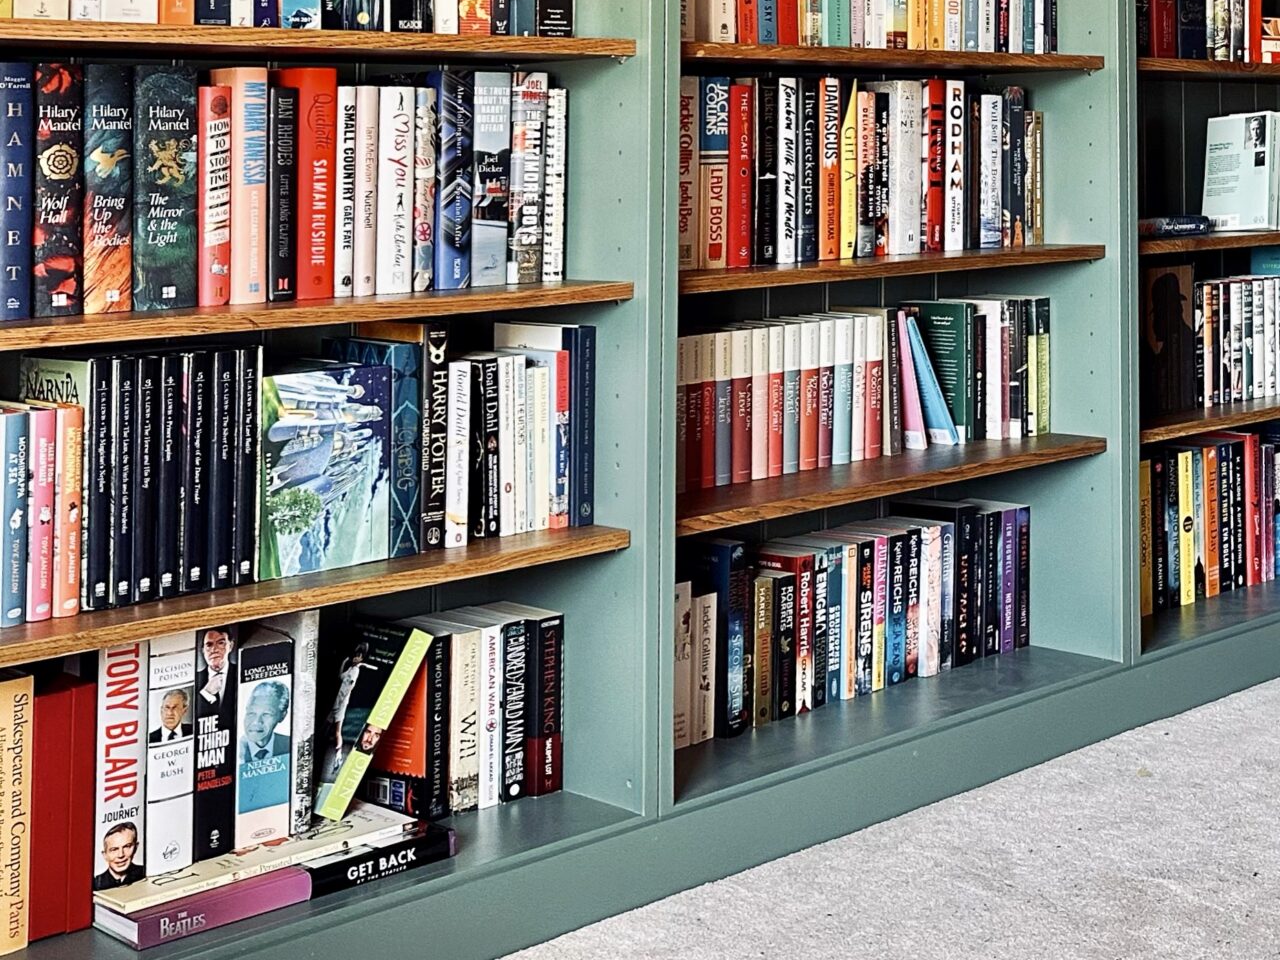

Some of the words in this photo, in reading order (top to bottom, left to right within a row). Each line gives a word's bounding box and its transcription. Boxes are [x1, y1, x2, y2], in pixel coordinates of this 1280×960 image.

[764, 6, 772, 23] SKY
[244, 82, 266, 100] MY
[805, 91, 815, 116] The
[39, 105, 78, 119] Hilary
[92, 105, 128, 119] Hilary
[149, 106, 184, 120] Hilary
[244, 103, 266, 132] DARK
[278, 98, 292, 119] DAN
[706, 84, 717, 135] COLLINS
[717, 84, 728, 134] JACKIE
[824, 84, 837, 159] DAMASCUS
[38, 118, 81, 130] Mantel
[91, 118, 132, 130] Mantel
[149, 119, 189, 131] Mantel
[344, 105, 355, 143] SMALL
[277, 124, 292, 166] RHODES
[950, 88, 963, 190] RODHAM
[209, 156, 230, 168] STOP
[243, 136, 266, 185] VANESSA
[343, 148, 355, 201] COUNTRY
[801, 120, 814, 215] Gracekeepers
[210, 173, 228, 184] TIME
[312, 159, 327, 210] SALMAN
[710, 168, 722, 202] LADY
[783, 171, 795, 199] Paul
[40, 196, 69, 210] Wolf
[94, 196, 125, 209] Bring
[148, 207, 183, 218] Mirror
[149, 193, 169, 205] The
[40, 211, 67, 224] Hall
[93, 221, 111, 233] the
[94, 209, 112, 222] Up
[148, 219, 157, 230] &
[160, 219, 177, 230] the
[710, 206, 722, 241] BOSS
[784, 202, 794, 240] Mendez
[148, 232, 178, 246] Light
[311, 214, 326, 267] RUSHDIE
[485, 363, 497, 399] Roald
[432, 370, 447, 424] HARRY
[486, 402, 497, 432] Dahl
[8, 453, 17, 466] AT
[16, 436, 26, 498] MOOMINPAPPA
[430, 433, 446, 498] POTTER
[8, 468, 17, 484] SEA
[1208, 468, 1217, 494] The
[1209, 498, 1217, 526] Last
[1207, 529, 1218, 554] Day
[800, 572, 810, 616] Robert
[893, 566, 903, 614] REICHS
[909, 559, 918, 605] REICHS
[800, 618, 810, 657] Harris
[860, 591, 872, 656] SIRENS
[544, 630, 557, 692] STEPHEN
[107, 644, 140, 710] TONY
[198, 714, 218, 732] THE
[544, 696, 555, 733] KING
[8, 693, 28, 786] Shakespeare
[198, 728, 230, 749] THIRD
[459, 711, 476, 760] Will
[104, 722, 138, 802] BLAIR
[154, 747, 190, 760] GEORGE
[198, 748, 225, 769] MAN
[247, 756, 282, 770] NELSON
[160, 767, 184, 779] BUSH
[242, 763, 286, 779] MANDELA
[11, 790, 25, 819] and
[102, 806, 140, 823] JOURNEY
[3, 822, 24, 897] Company
[347, 859, 376, 880] GET
[379, 848, 417, 871] BACK
[9, 901, 24, 939] Paris
[160, 913, 206, 940] BEATLES
